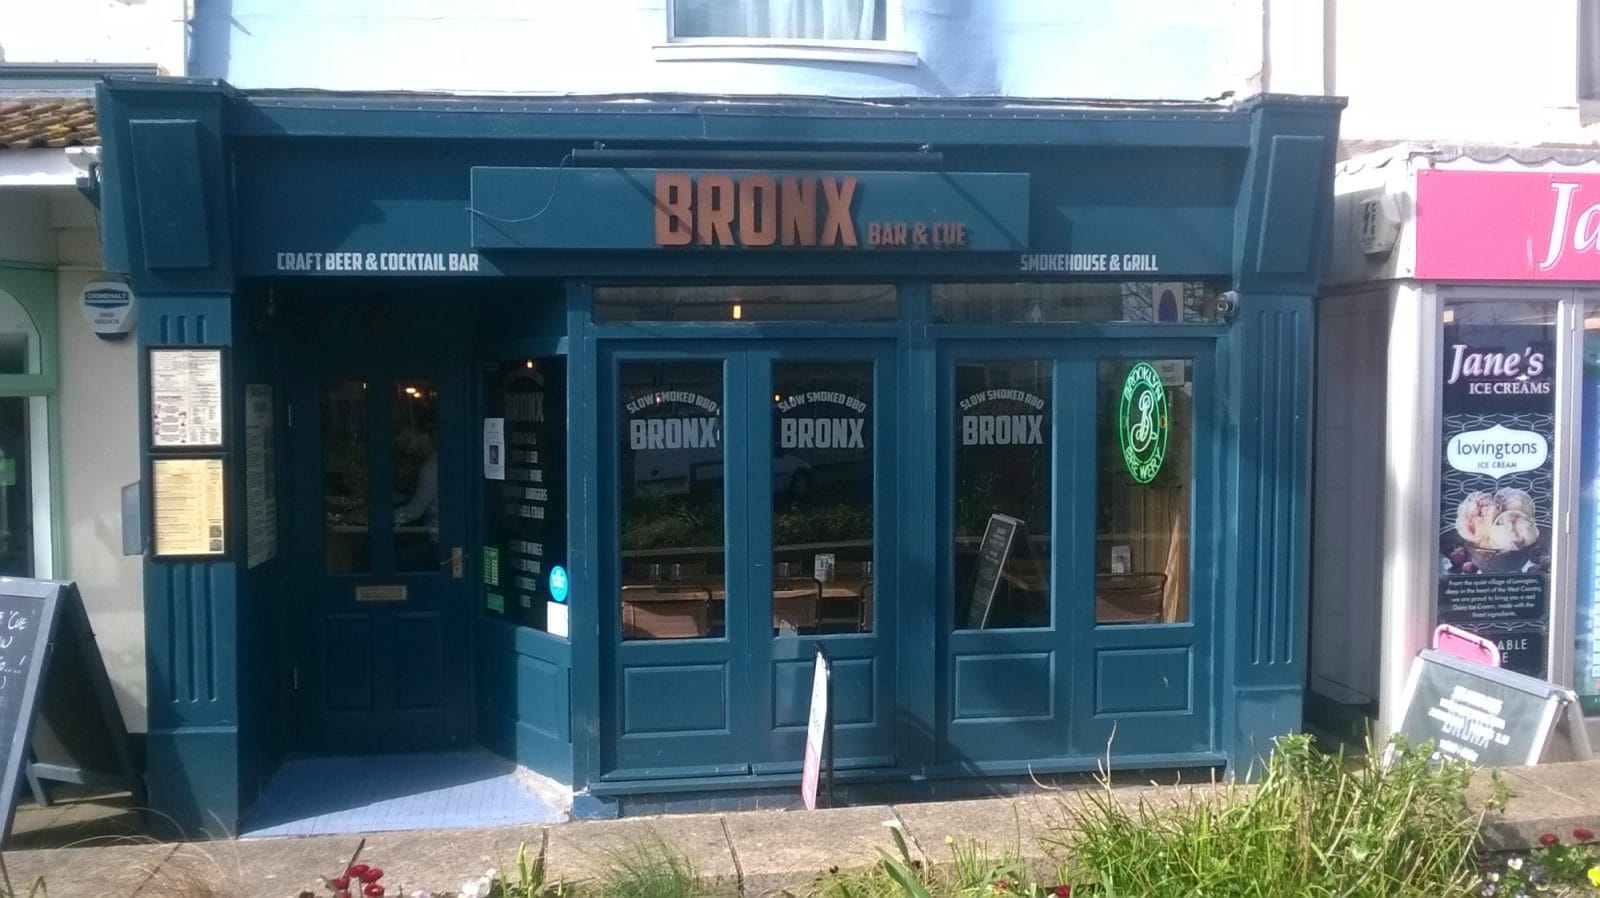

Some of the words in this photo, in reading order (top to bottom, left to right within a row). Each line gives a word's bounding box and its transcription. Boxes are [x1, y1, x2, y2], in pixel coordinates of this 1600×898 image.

[655, 174, 858, 247] BRONX
[868, 222, 907, 247] BAR
[912, 222, 927, 246] &
[932, 221, 966, 247] CUE
[277, 252, 322, 271] CRAFT
[325, 252, 362, 271] BEER
[365, 252, 378, 271] &
[380, 252, 446, 271] COCKTAIL
[448, 252, 479, 272] BAR
[1020, 253, 1106, 271] SMOKEHOUSE
[1109, 254, 1120, 271] &
[1123, 253, 1158, 271] GRILL
[1447, 344, 1545, 385] Jane's
[1124, 366, 1164, 401] BROOKLYN
[1469, 382, 1491, 394] ICE
[1493, 382, 1550, 394] CREAMS
[626, 394, 654, 414] SLOW
[657, 391, 696, 404] SMOKED
[778, 394, 806, 413] SLOW
[806, 391, 845, 405] SMOKED
[959, 390, 986, 411] SLOW
[986, 389, 1024, 402] SMOKED
[630, 418, 717, 450] BRONX
[781, 418, 865, 449] BRONX
[962, 415, 1044, 445] BRONX
[1457, 439, 1538, 459] lovingtons
[1124, 446, 1161, 480] BREWERY
[1477, 461, 1489, 469] ICE
[1492, 461, 1517, 469] CREAM
